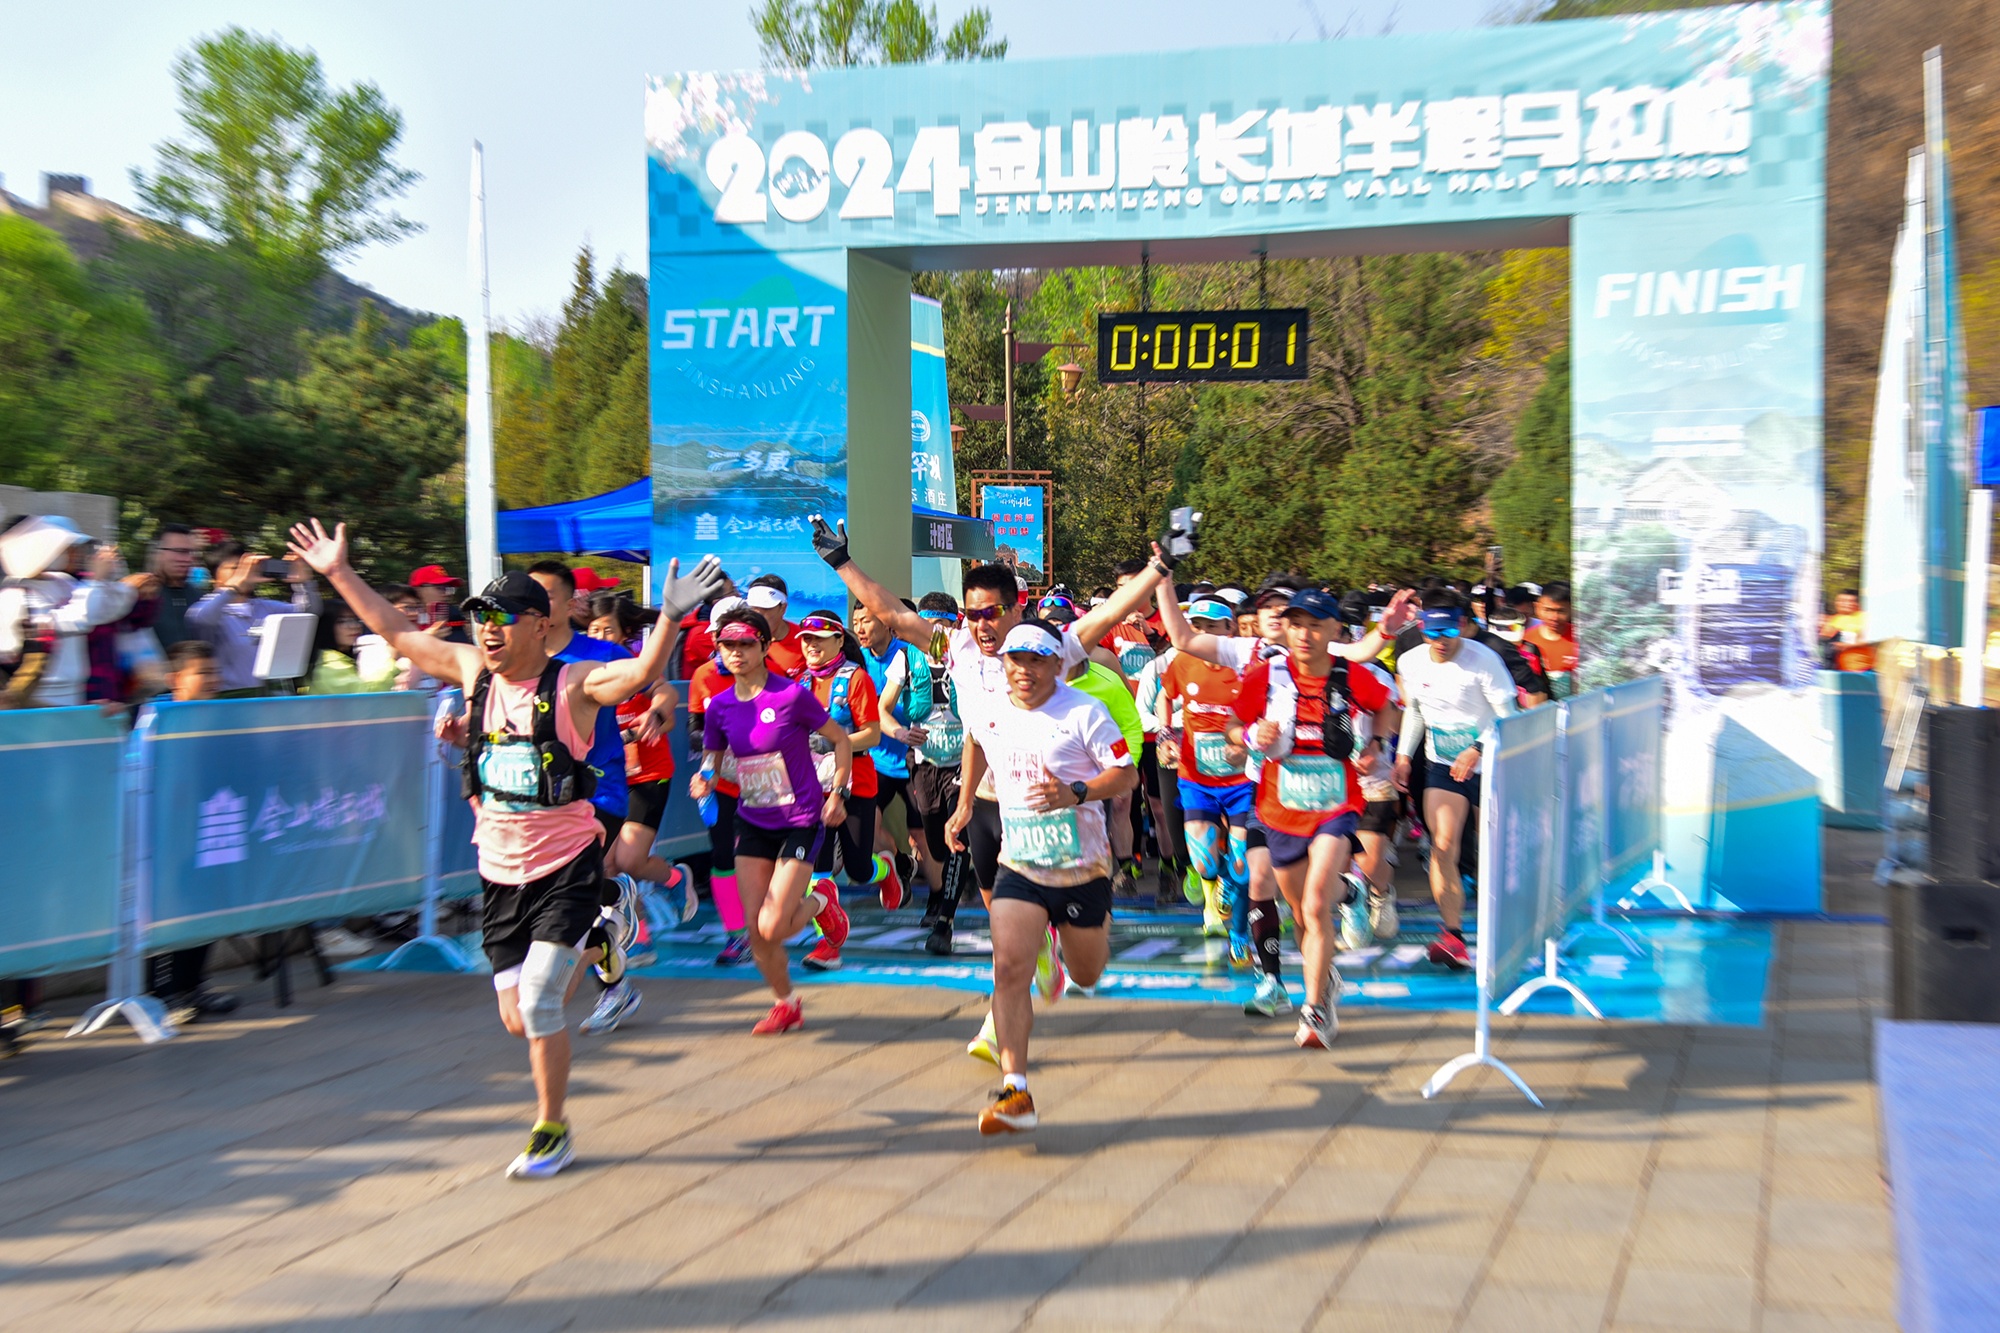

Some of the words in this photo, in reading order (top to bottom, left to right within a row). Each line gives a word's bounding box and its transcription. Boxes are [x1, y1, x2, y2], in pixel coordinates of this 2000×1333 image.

[975, 187, 1204, 215] JINSHANLING
[1220, 181, 1328, 206] GREAT
[1343, 175, 1431, 199] WALL
[1448, 169, 1539, 193] HALF
[1593, 263, 1807, 318] FINISH
[661, 306, 836, 349] START
[1110, 322, 1298, 371] 0:00:01
[676, 355, 816, 400] JINSHANLING
[929, 522, 954, 551] 计时区
[1008, 822, 1073, 850] M1033
